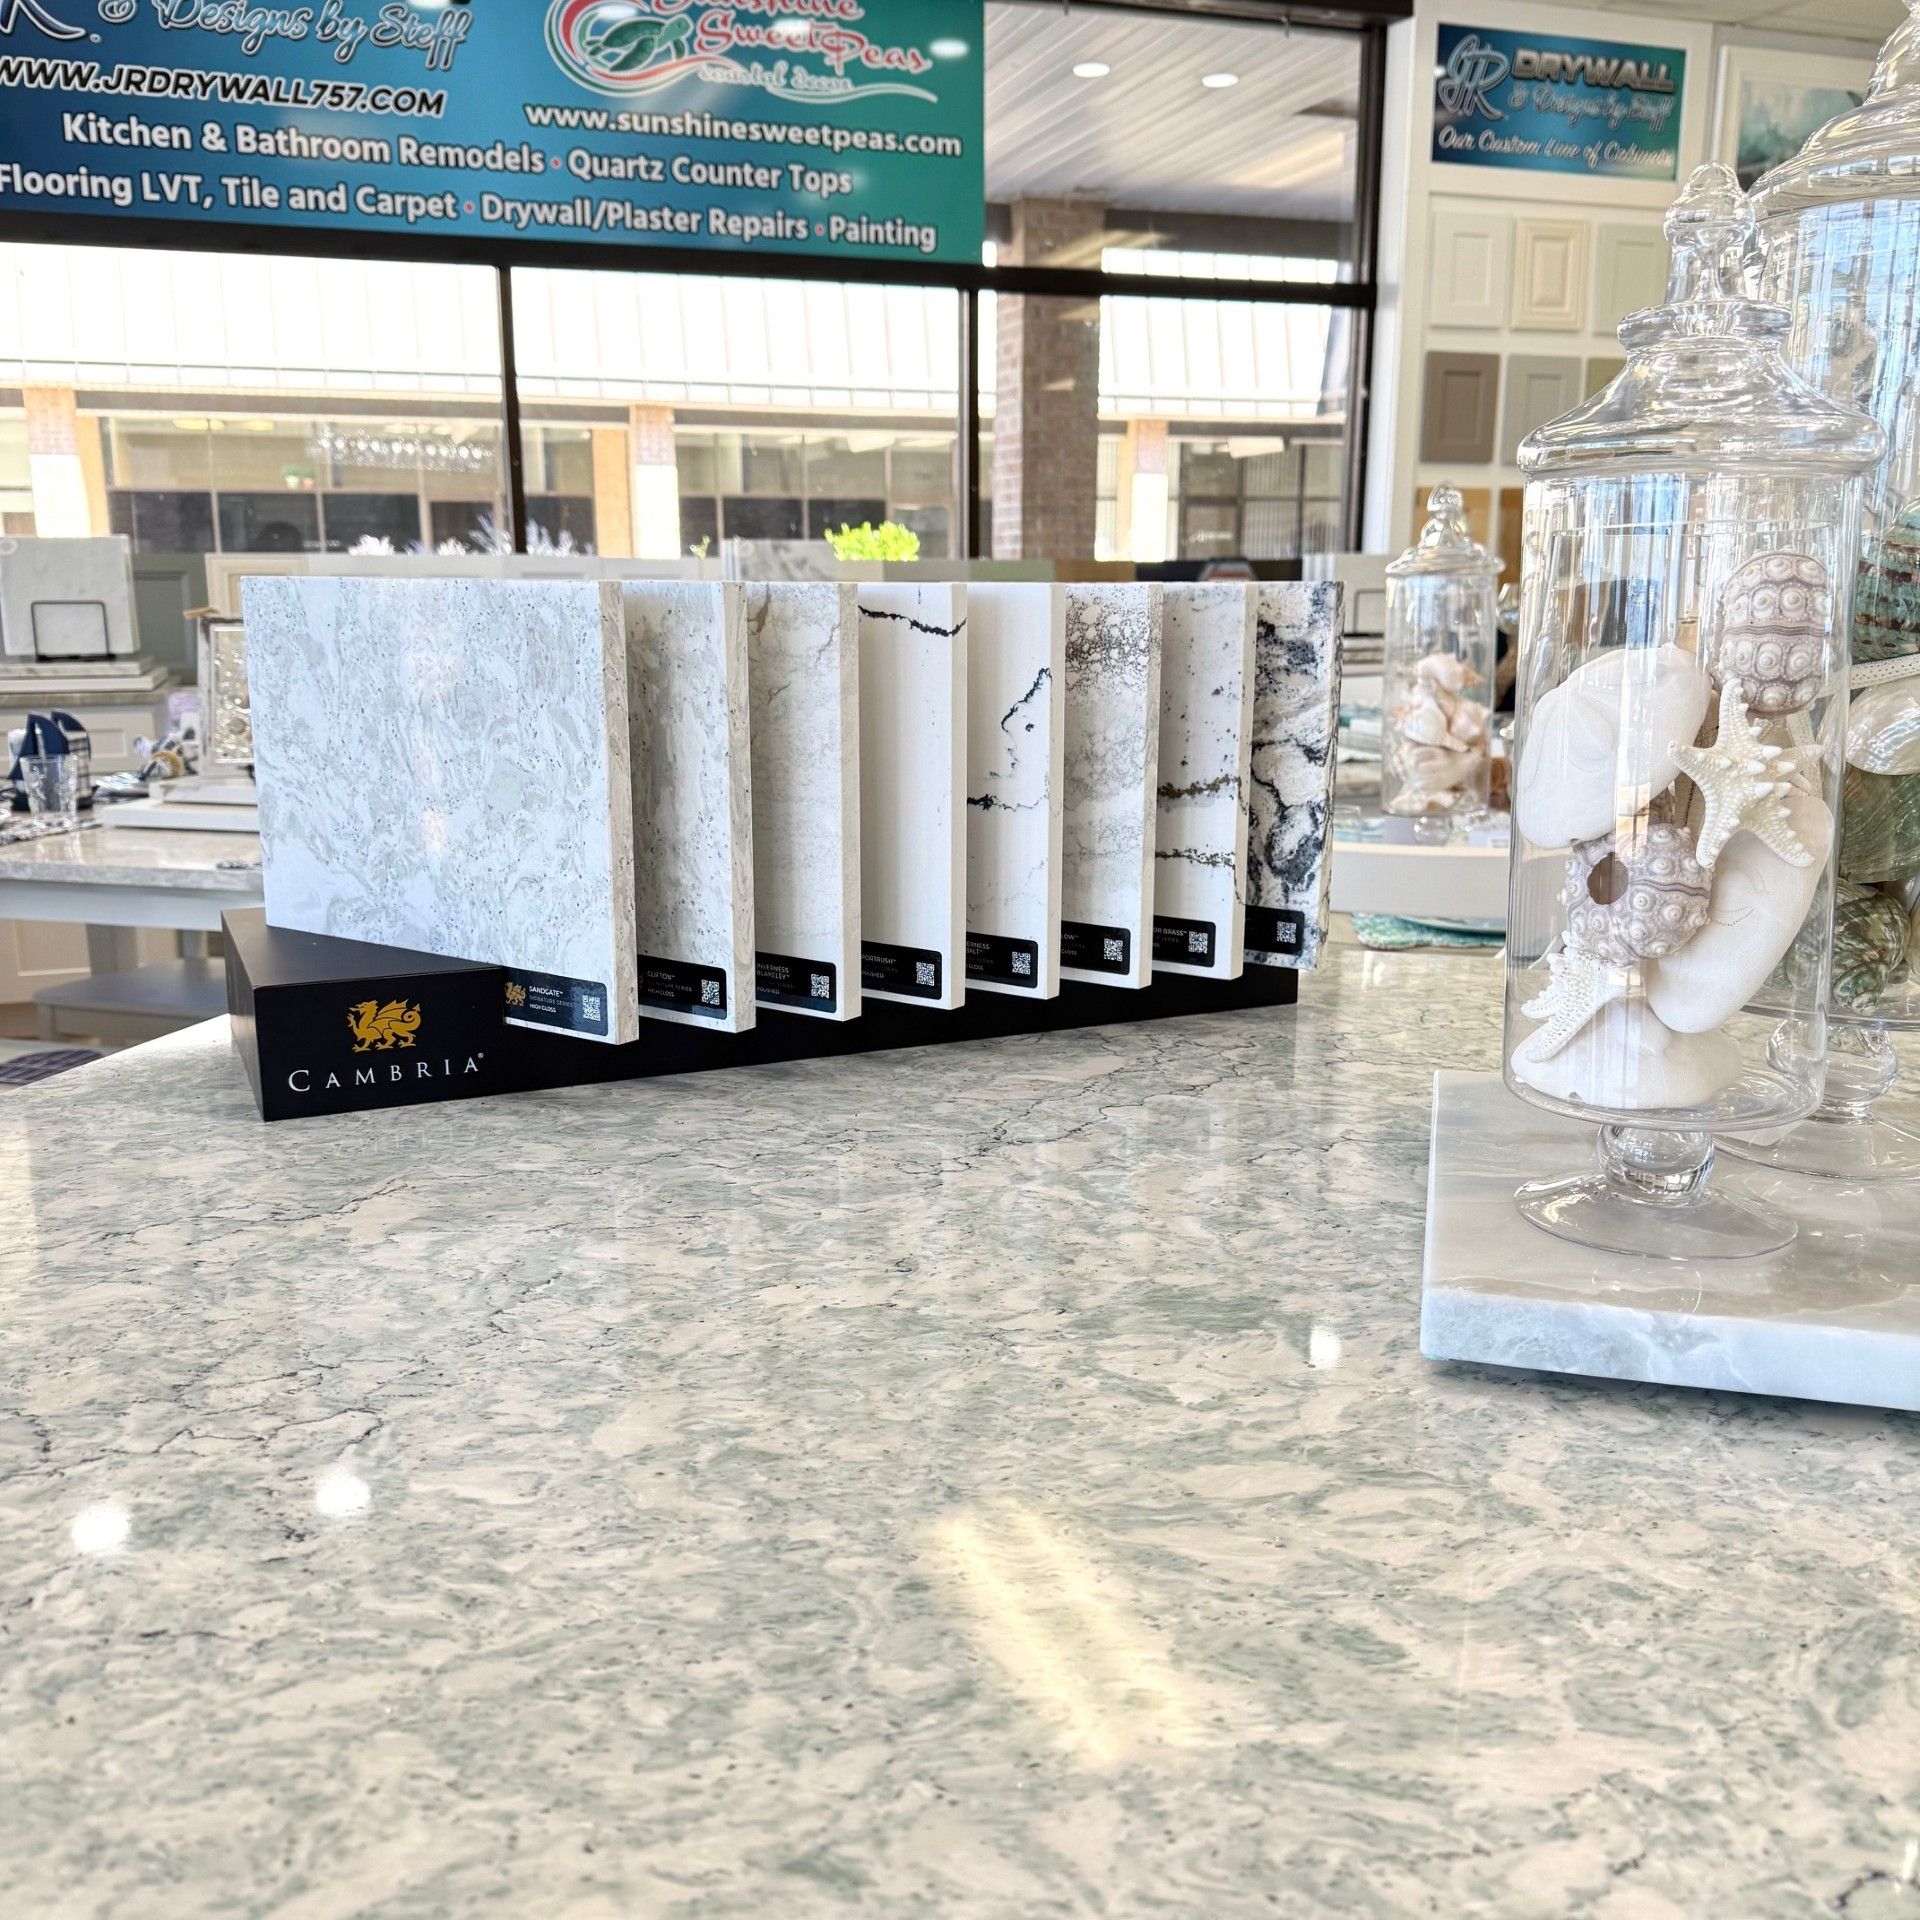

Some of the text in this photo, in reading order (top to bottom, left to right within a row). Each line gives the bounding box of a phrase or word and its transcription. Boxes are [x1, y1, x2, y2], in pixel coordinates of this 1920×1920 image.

[153, 0, 315, 56] Designs
[316, 0, 369, 64] by
[370, 3, 474, 70] Steff
[0, 56, 447, 118] WWW.JRDRYWALL757.COM
[1510, 48, 1676, 94] DRYWALL
[62, 112, 853, 199] Kitchen & Bathroom Remodels Quartz Counter Tops
[524, 104, 963, 157] www.sunshinesweetpeas.com
[1438, 126, 1476, 151] Our
[1478, 129, 1541, 156] Custom
[1582, 139, 1604, 169] of
[0, 163, 937, 252] Flooring LVT, Tile and Carpet Drywall/Plaster Repairs Painting
